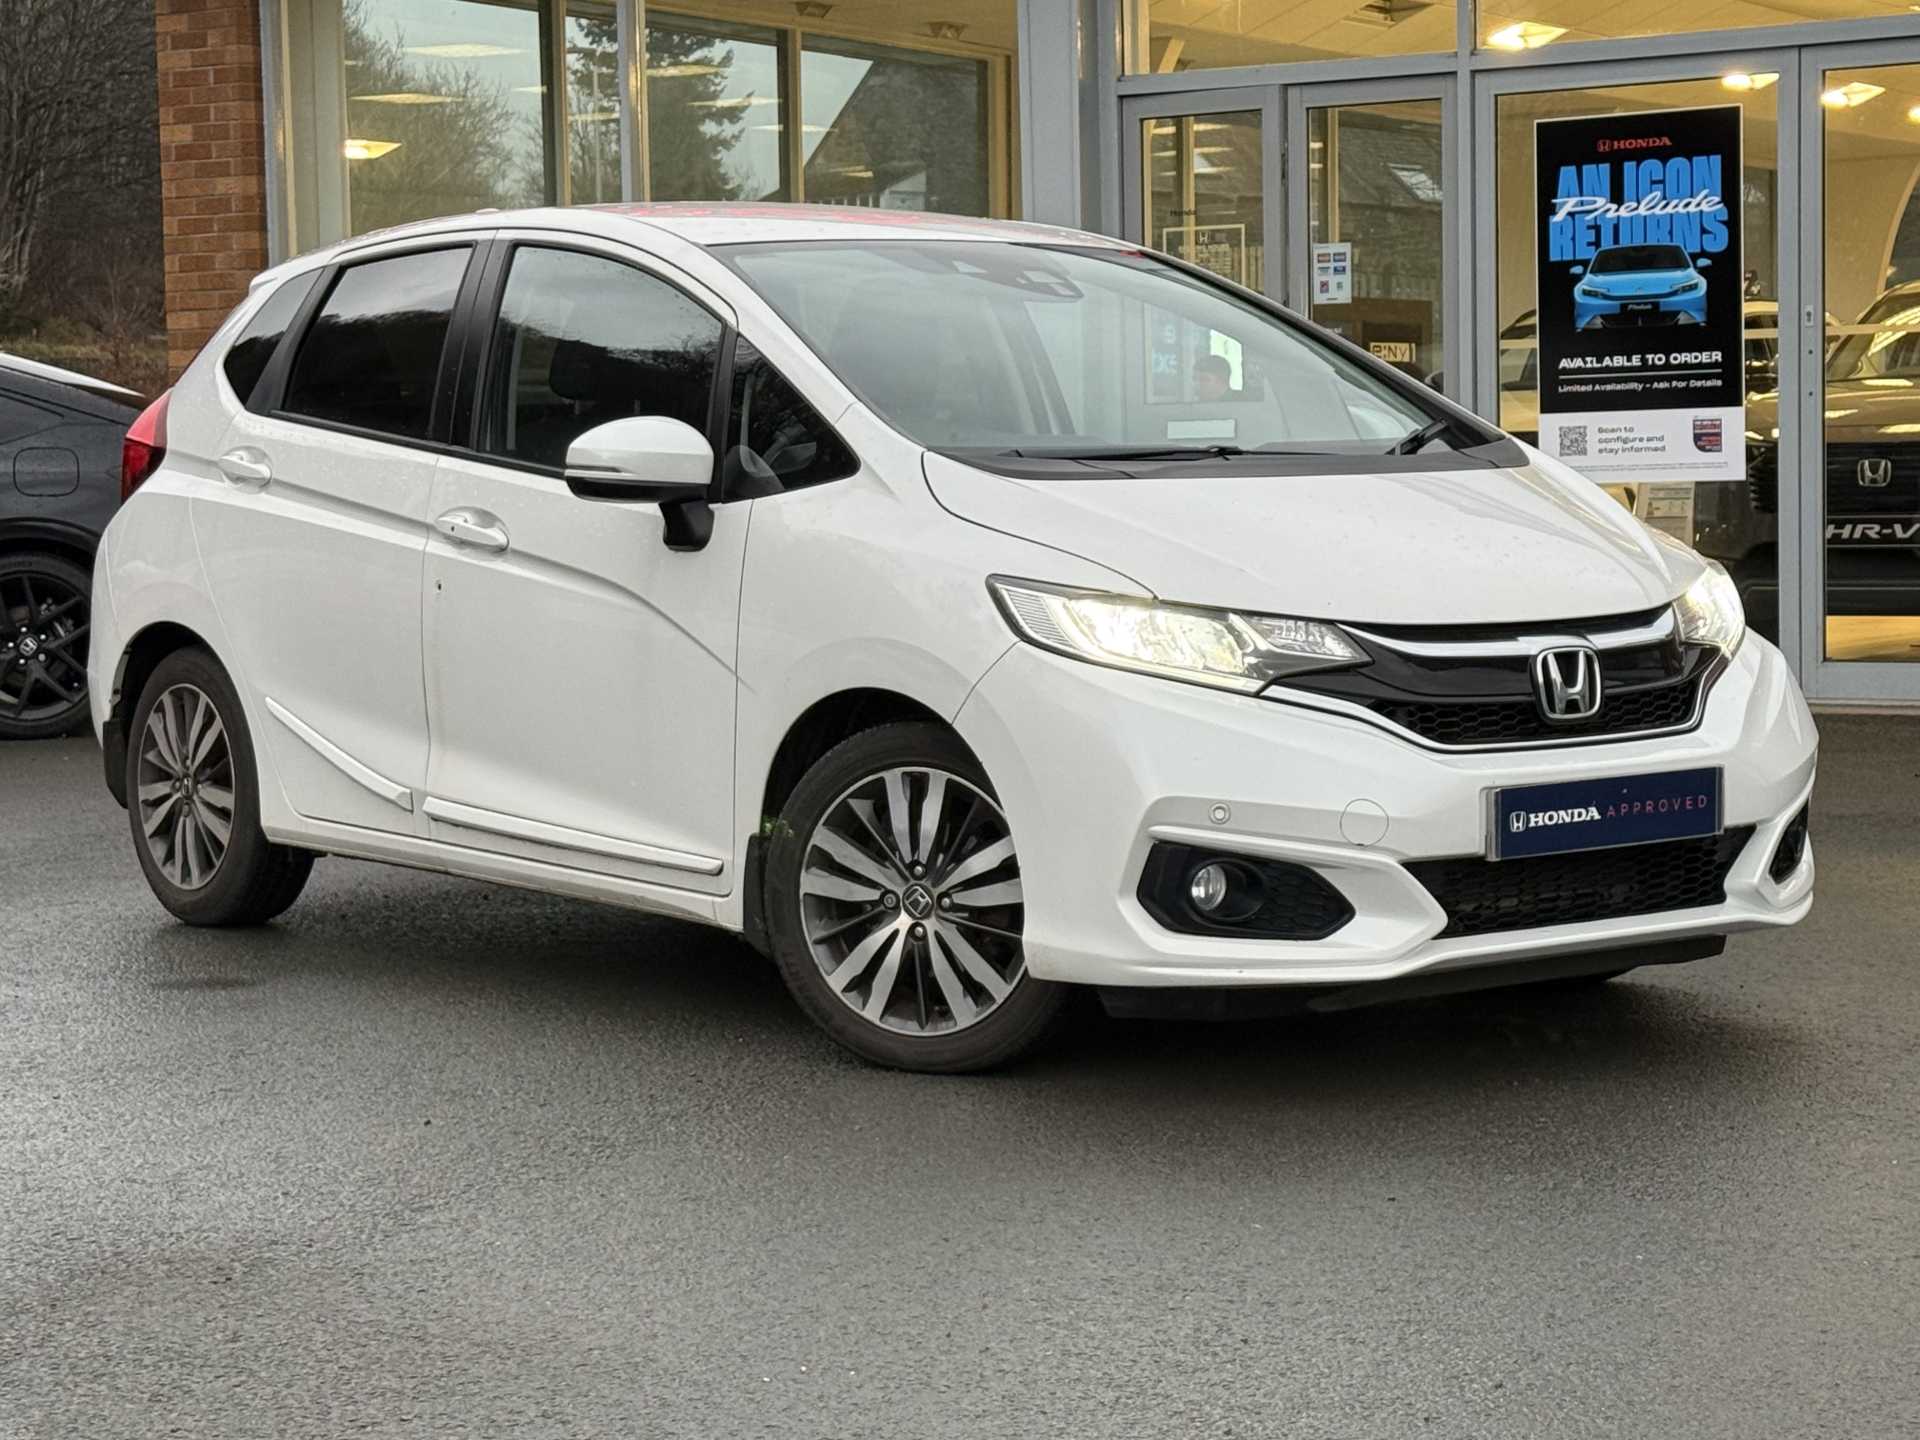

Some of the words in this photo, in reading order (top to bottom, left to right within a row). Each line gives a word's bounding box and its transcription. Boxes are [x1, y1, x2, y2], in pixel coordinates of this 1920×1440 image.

[1613, 137, 1672, 150] HONDA
[1555, 163, 1610, 212] AN
[1623, 155, 1722, 207] ICON
[1552, 189, 1724, 222] Prelude
[1549, 205, 1729, 261] RETURNS
[1558, 355, 1642, 369] AVAILABLE
[1645, 353, 1666, 365] TO
[1669, 351, 1722, 364] ORDER
[1558, 383, 1592, 393] Limited
[1594, 381, 1644, 392] Availability
[1652, 381, 1670, 389] Ask
[1671, 380, 1688, 388] For
[1689, 378, 1722, 388] Details
[1598, 435, 1645, 444] configure
[1646, 434, 1665, 442] and
[1598, 446, 1620, 455] stay
[1621, 444, 1666, 453] informed
[1825, 523, 1920, 539] HR-V
[1528, 806, 1601, 828] HONDA
[1606, 795, 1708, 818] APPROVED
